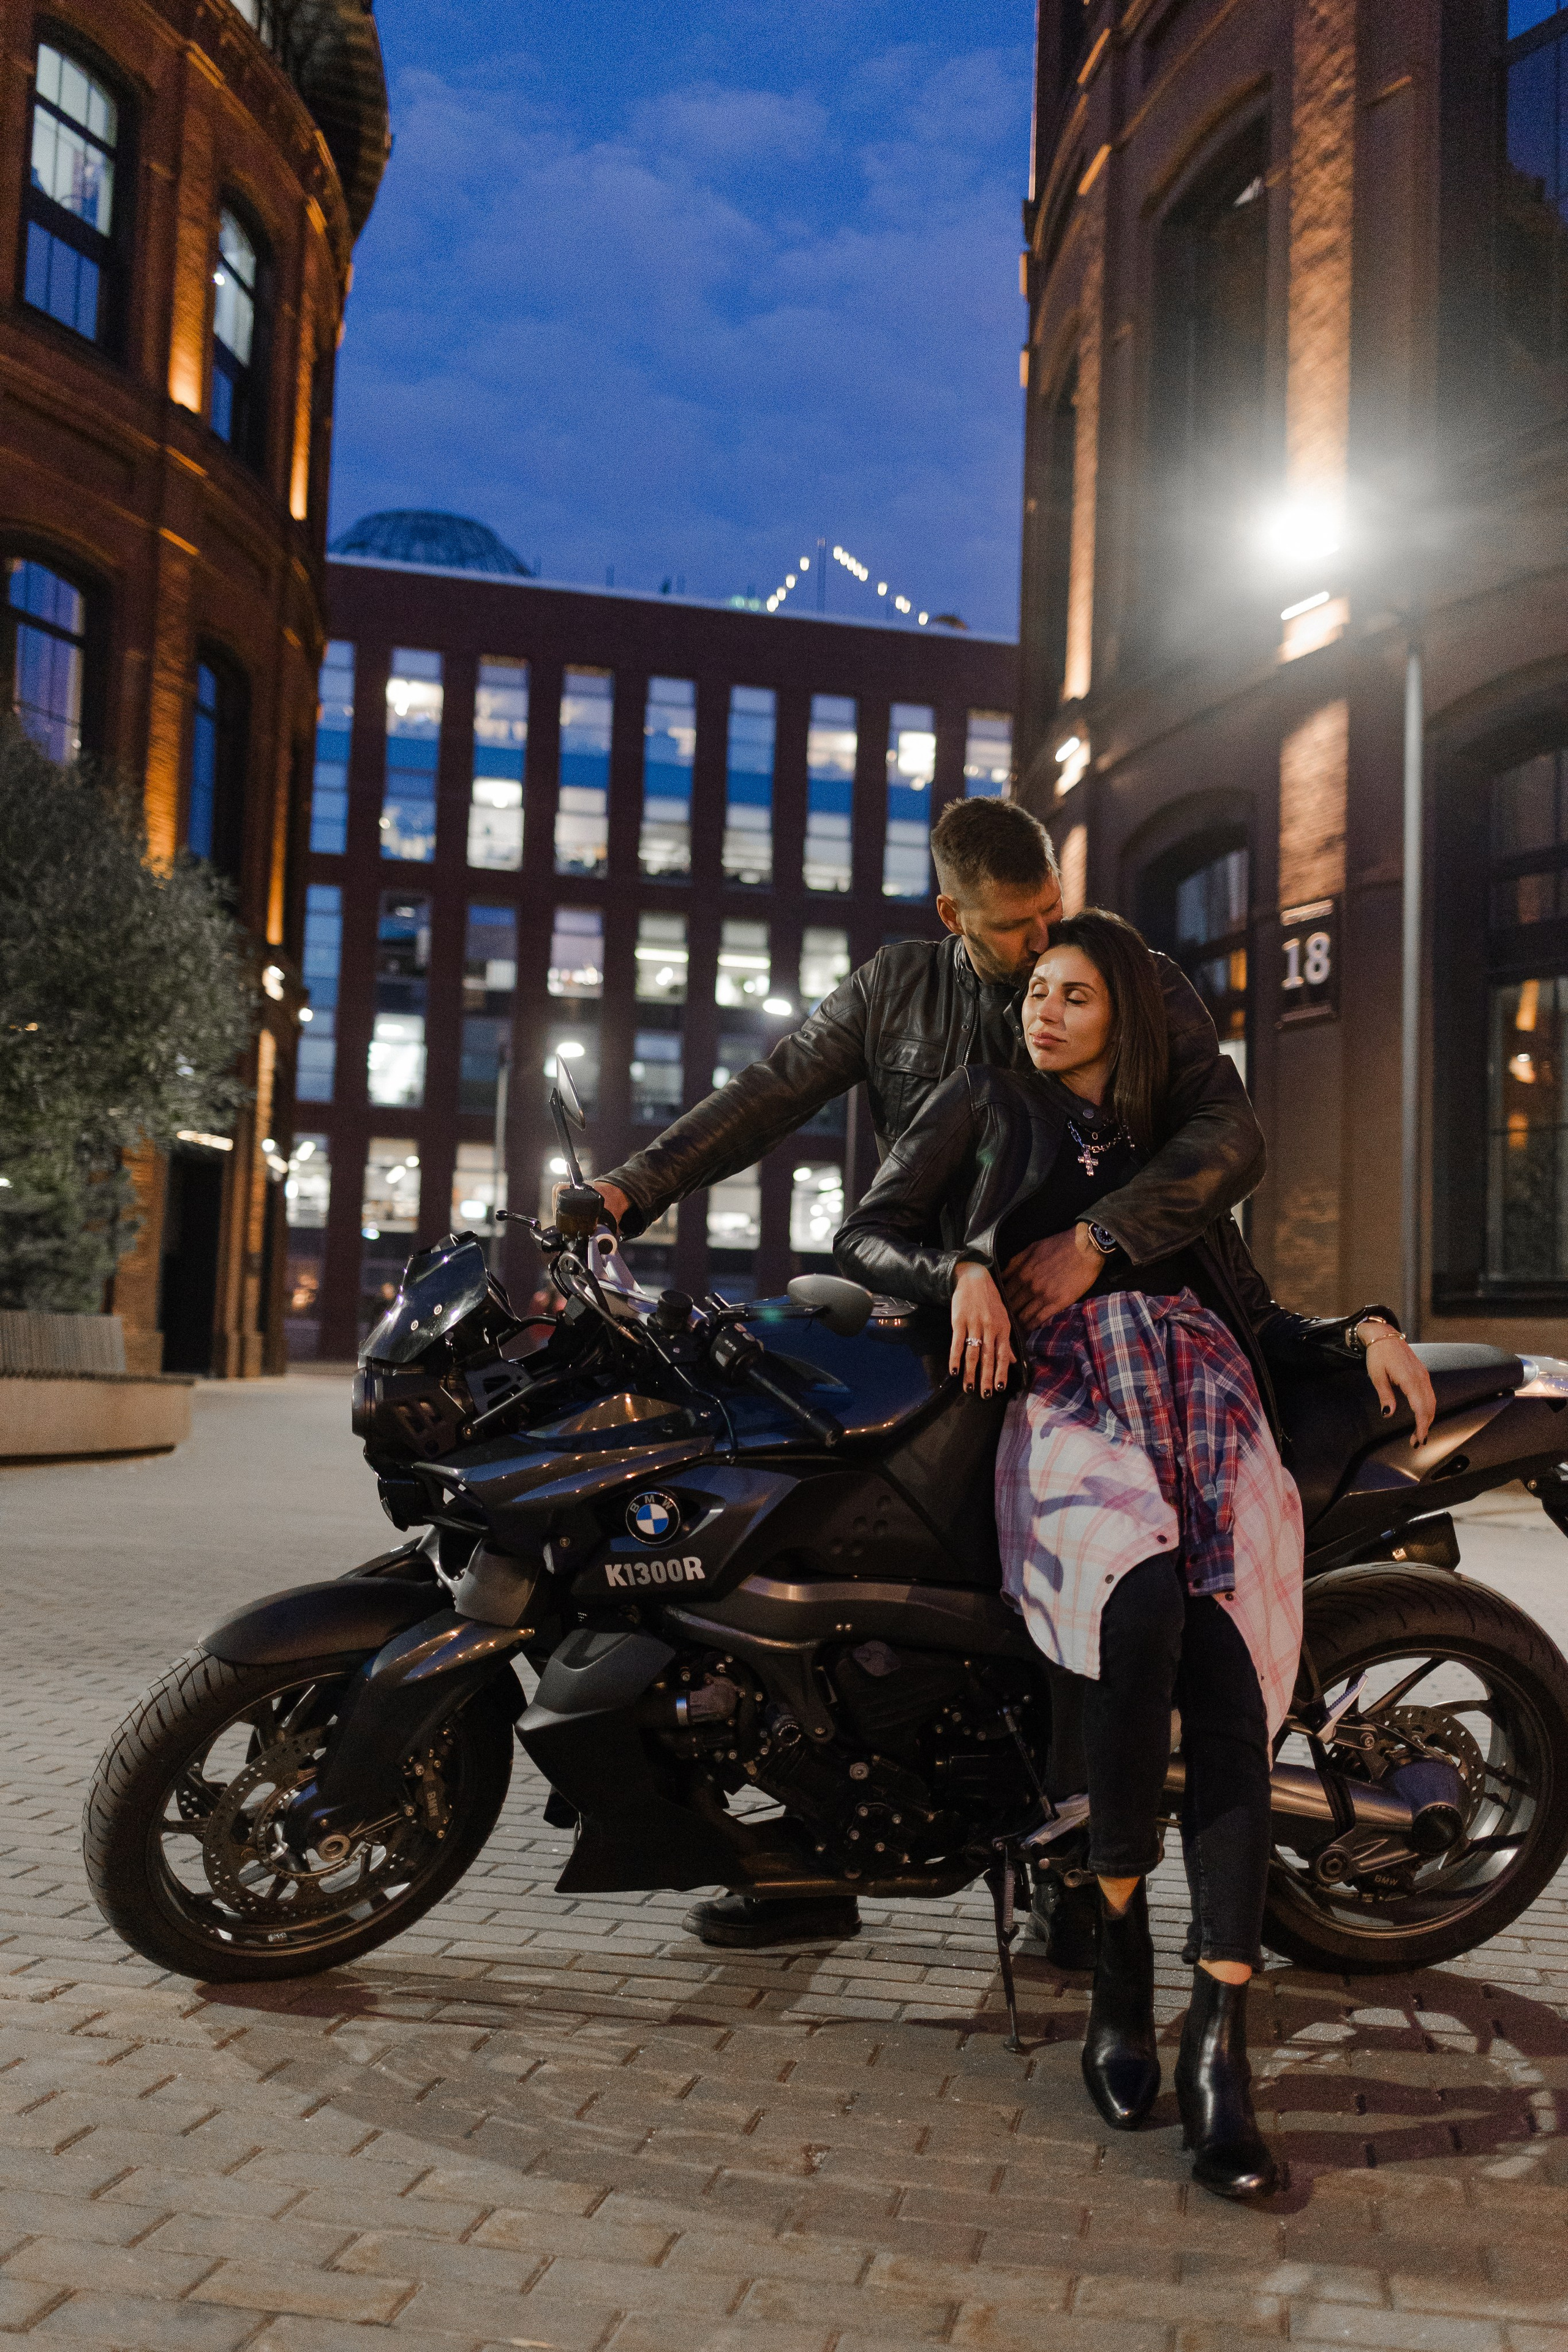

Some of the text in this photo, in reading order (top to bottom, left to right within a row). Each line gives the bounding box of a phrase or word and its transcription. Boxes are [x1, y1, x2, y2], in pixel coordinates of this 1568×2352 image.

[1281, 932, 1331, 990] 18
[630, 1494, 673, 1513] BMW
[605, 1556, 706, 1587] K1300R
[1374, 1874, 1398, 1885] BMW
